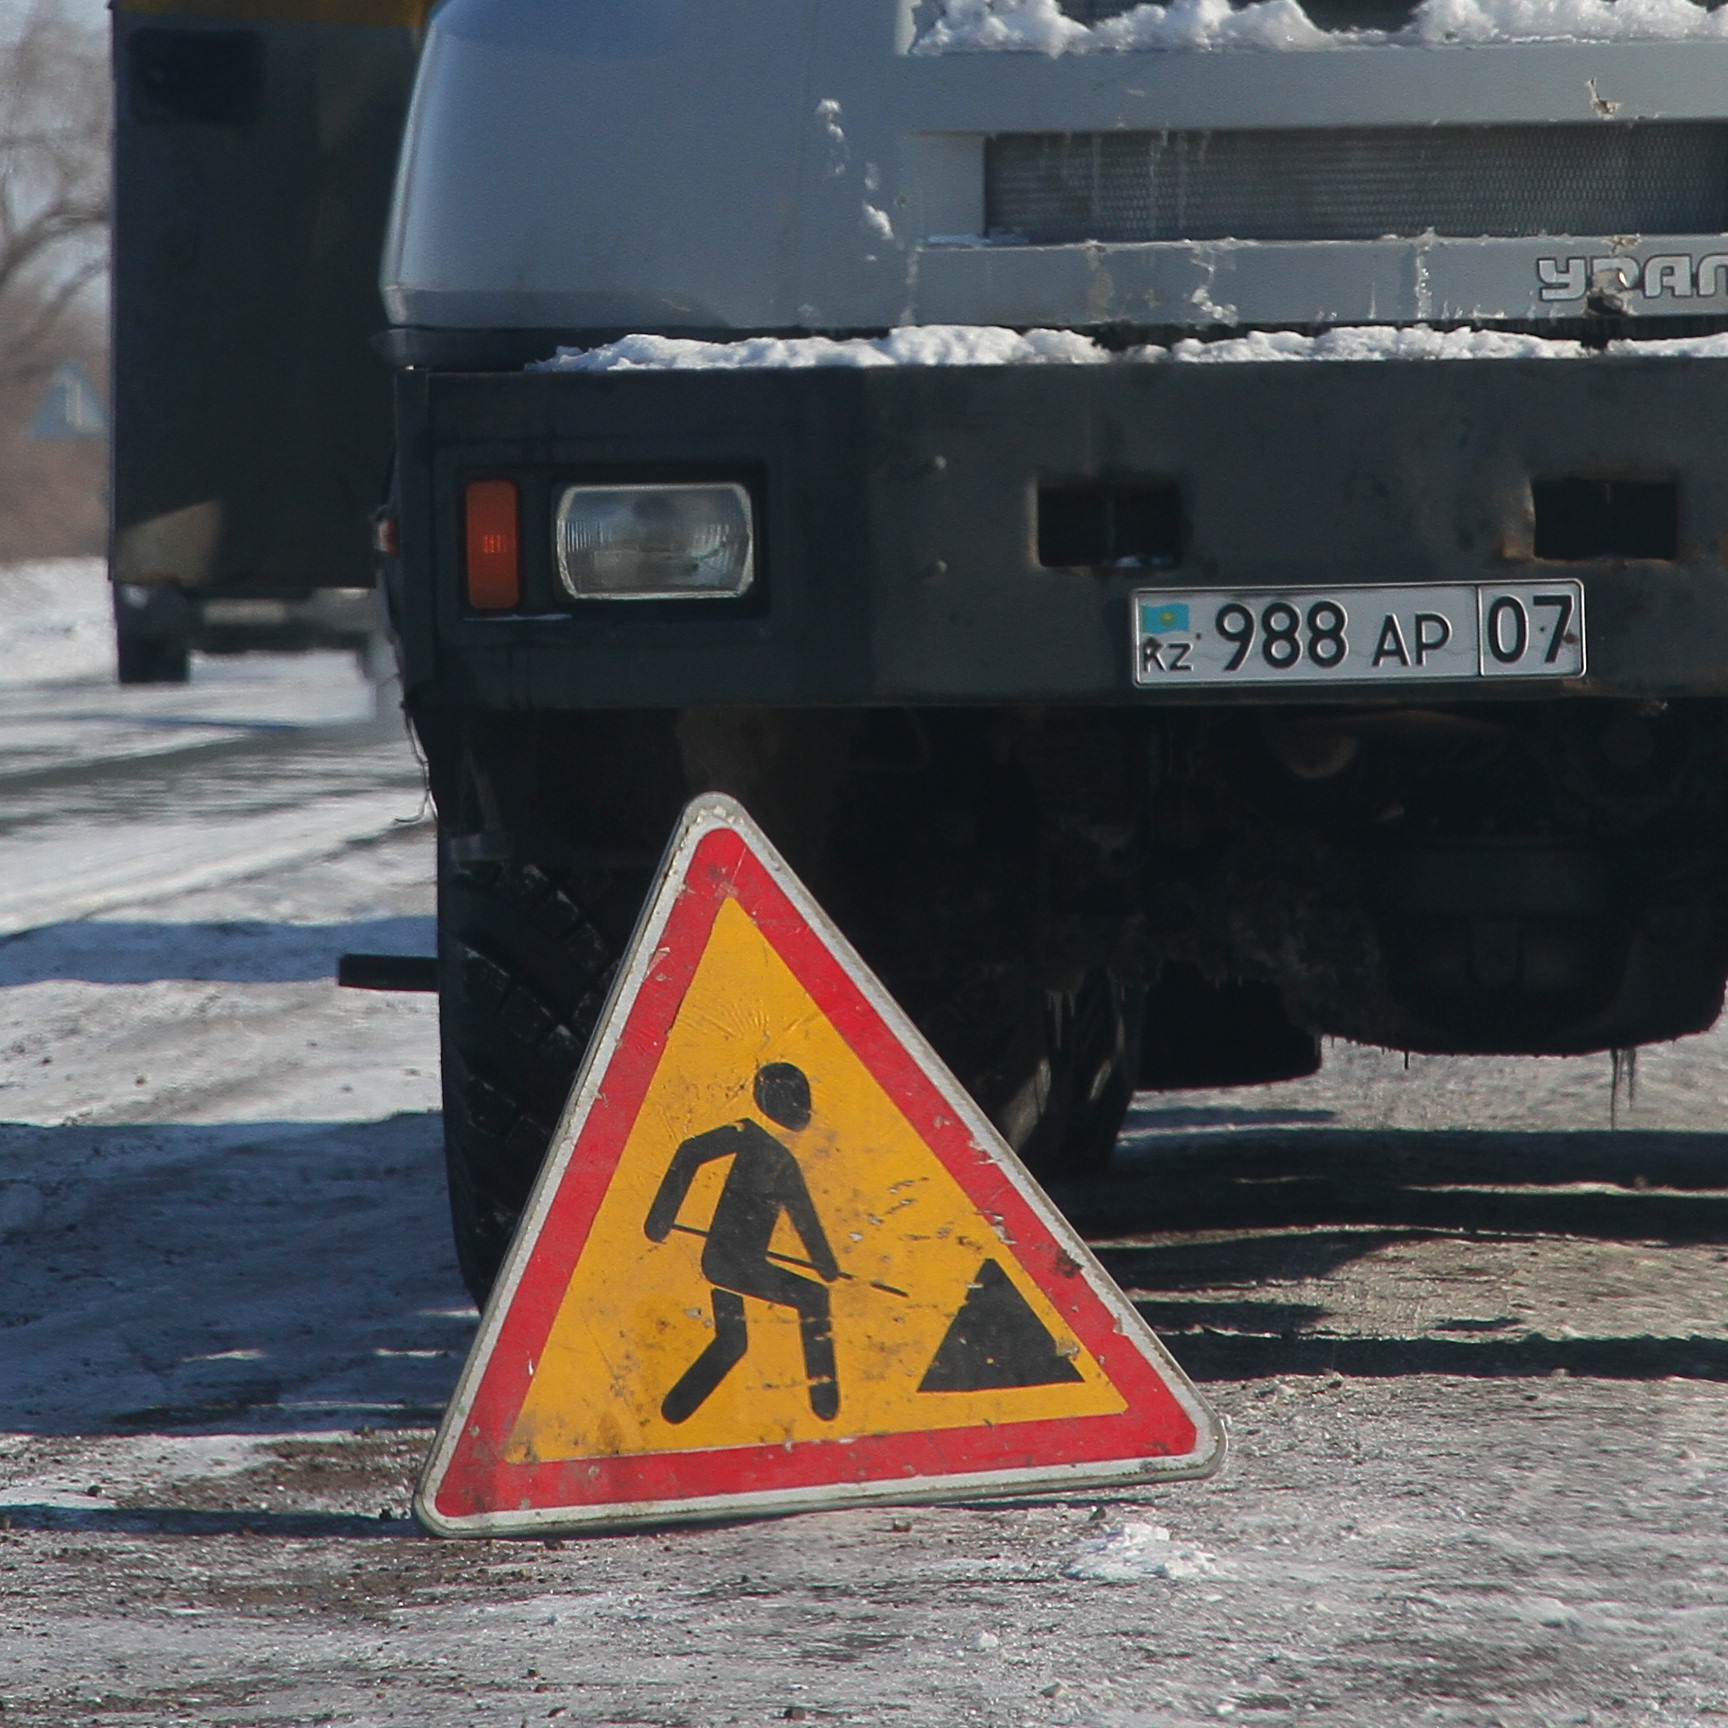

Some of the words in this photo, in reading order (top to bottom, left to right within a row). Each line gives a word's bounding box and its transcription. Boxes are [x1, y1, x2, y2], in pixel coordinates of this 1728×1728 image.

[1214, 600, 1349, 672] 988
[1372, 612, 1452, 667] AP
[1486, 593, 1574, 665] 07
